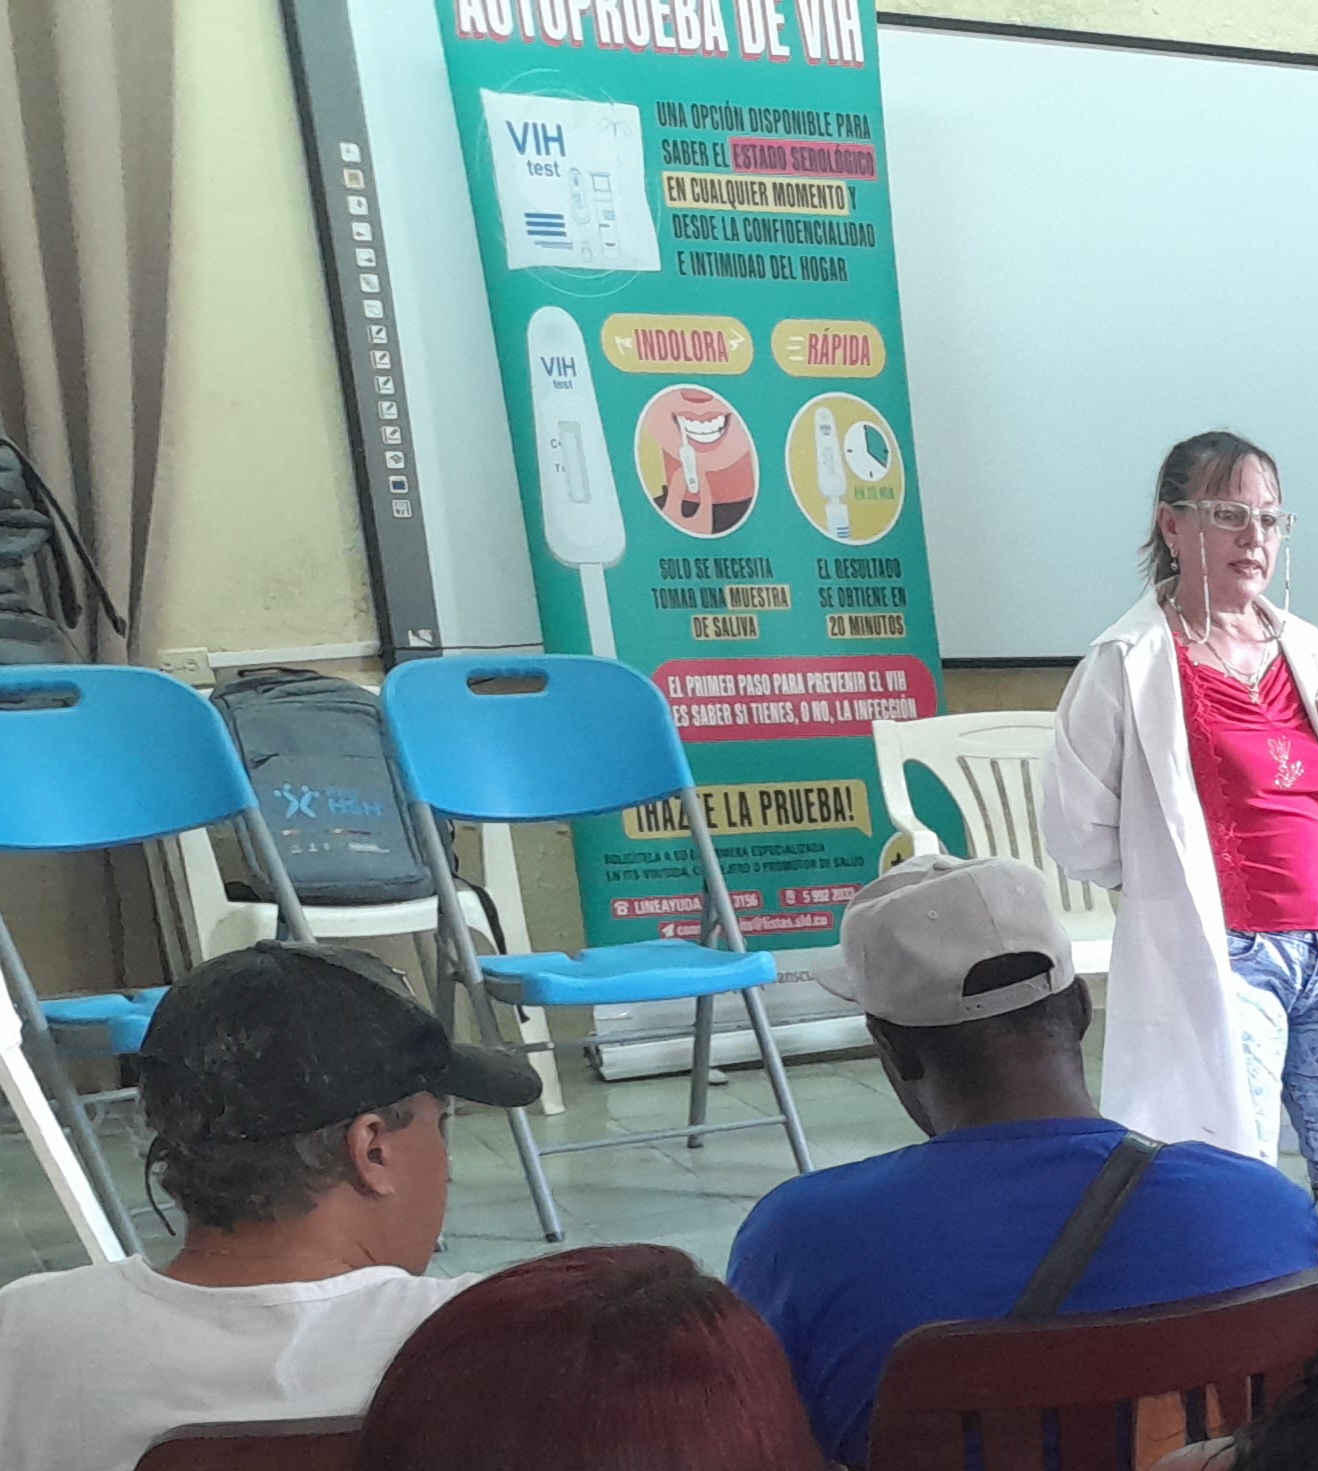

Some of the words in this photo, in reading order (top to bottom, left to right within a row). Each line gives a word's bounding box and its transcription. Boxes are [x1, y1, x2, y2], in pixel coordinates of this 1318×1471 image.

[656, 101, 688, 128] UNA
[691, 100, 745, 132] OPCIÓN
[749, 107, 832, 137] DISPONIBLE
[836, 112, 871, 139] PARA
[505, 120, 566, 157] VIH
[662, 138, 709, 167] SABER
[712, 142, 729, 168] EL
[733, 143, 787, 170] ESTADO
[527, 160, 561, 177] test
[666, 176, 687, 202] EN
[691, 177, 769, 209] CUALQUIER
[772, 182, 845, 210] MOMENTO
[849, 186, 857, 210] Y
[672, 213, 717, 240] DESDE
[721, 216, 739, 241] LA
[743, 217, 876, 247] CONFIDENCIALIDAD
[677, 251, 687, 276] E
[690, 251, 766, 279] INTIMIDAD
[770, 255, 797, 280] DEL
[800, 256, 848, 282] HOGAR
[634, 329, 729, 363] INDOLORA
[807, 328, 871, 366] RÁPIDA
[540, 357, 577, 377] VIH
[694, 558, 711, 579] SE
[730, 586, 789, 608] MUESTRA
[693, 617, 710, 637] DE
[713, 615, 757, 637] SALIVA
[830, 616, 845, 636] 20
[849, 615, 904, 636] MINUTOS
[668, 676, 684, 697] EL
[687, 675, 735, 697] PRIMER
[738, 674, 770, 695] PASO
[773, 673, 804, 694] PARA
[869, 671, 883, 692] EL
[886, 670, 907, 691] VIH
[672, 705, 689, 726] ES
[691, 703, 732, 726] SABER
[734, 703, 748, 724] SI
[836, 700, 853, 721] LA
[723, 790, 753, 828] LA
[759, 786, 855, 827] PRUEBA!
